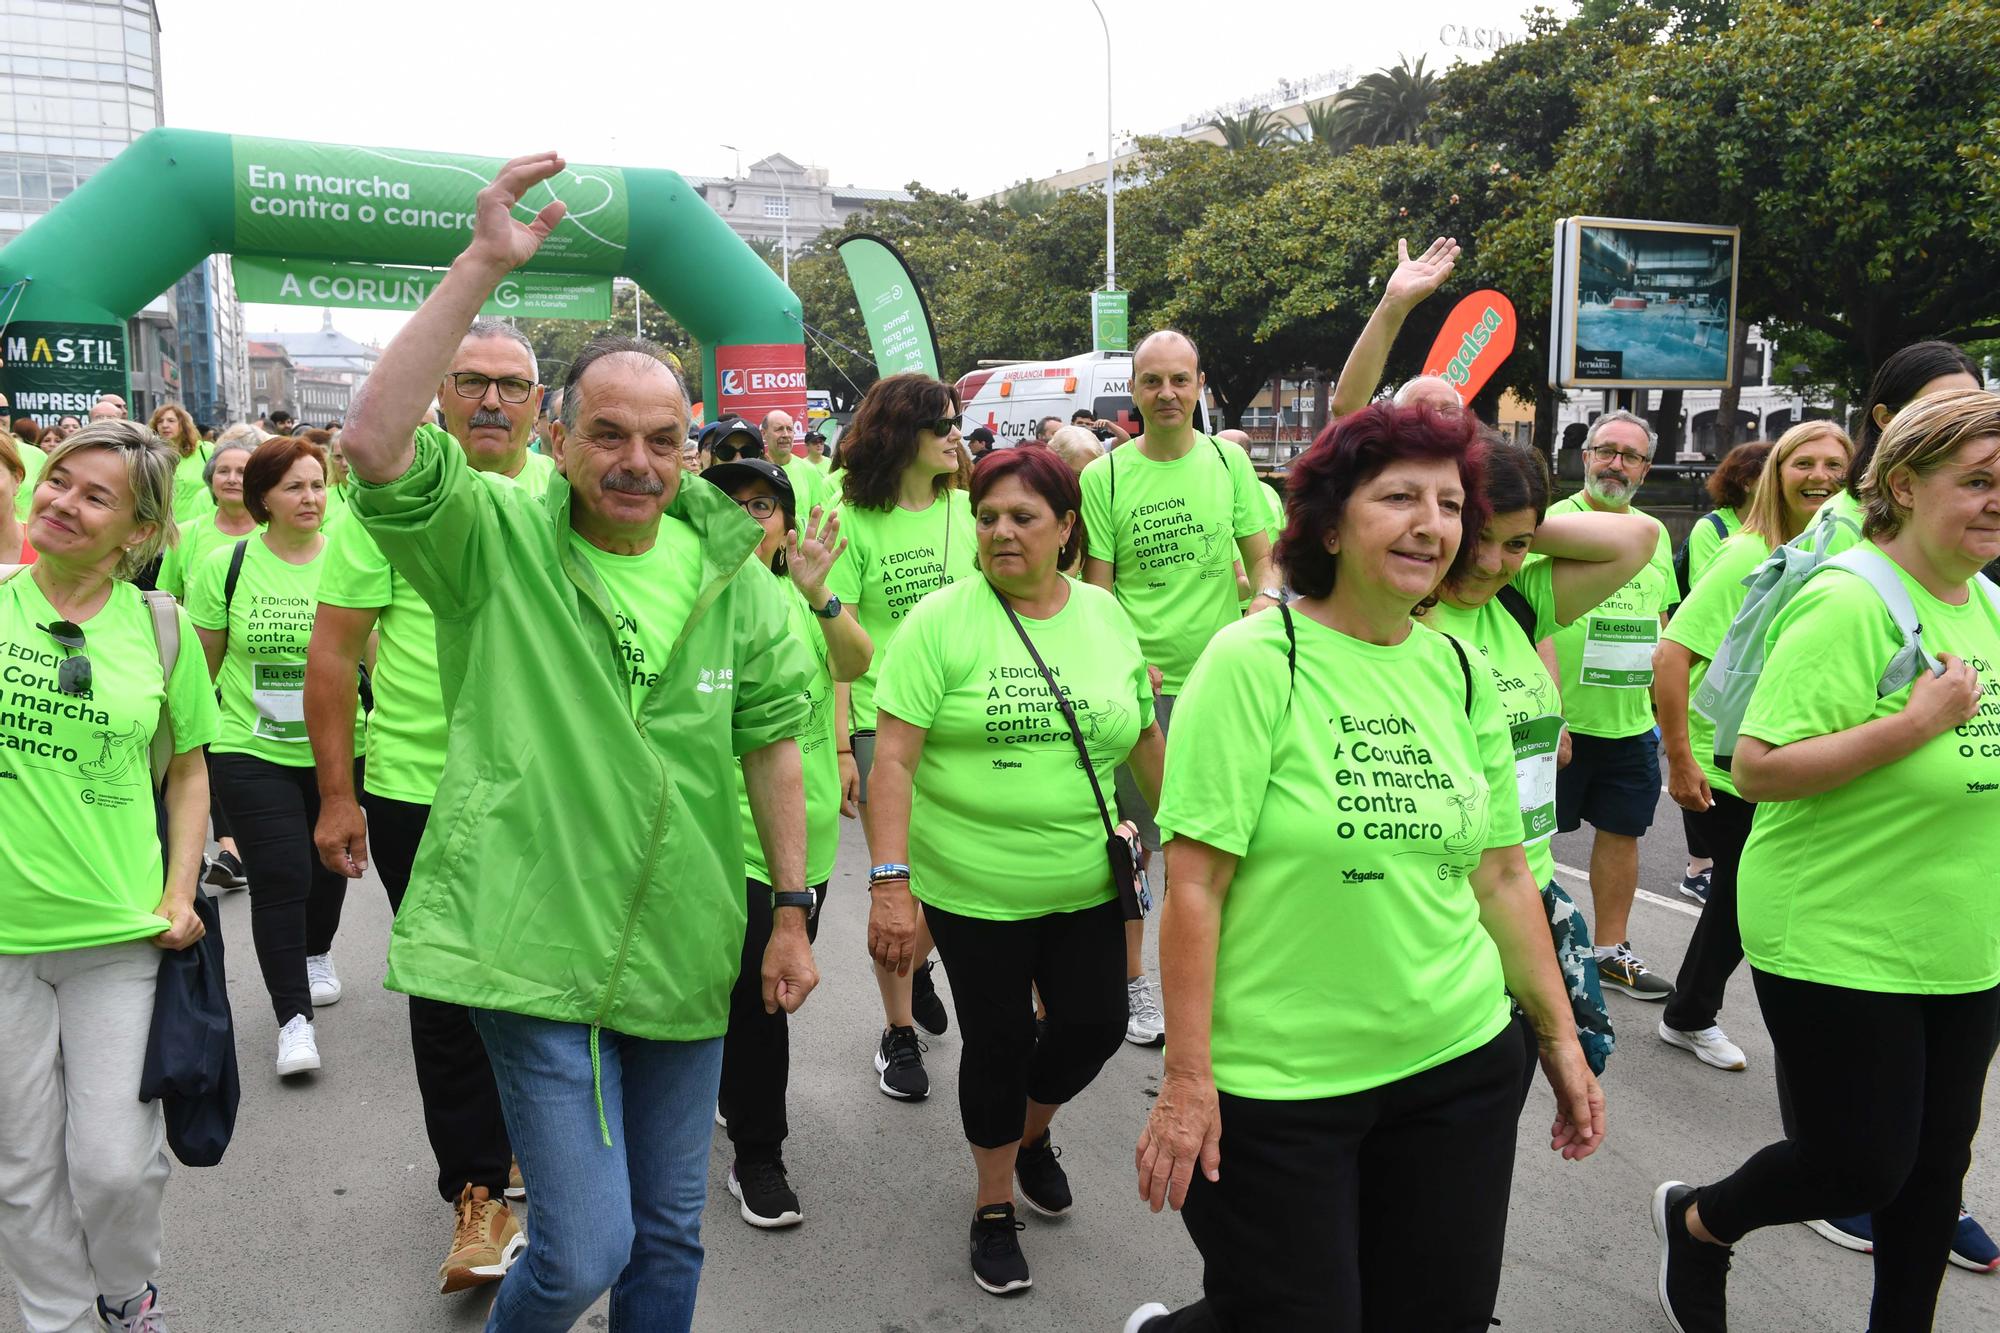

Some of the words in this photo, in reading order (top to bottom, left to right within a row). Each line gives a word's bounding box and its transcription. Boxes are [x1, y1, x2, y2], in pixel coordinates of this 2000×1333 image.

[248, 164, 286, 190] En
[294, 173, 410, 200] marcha
[250, 195, 350, 221] contra
[358, 204, 376, 224] o
[280, 272, 302, 298] A
[309, 275, 438, 304] CORUÑ
[7, 336, 118, 364] MASTIL
[1430, 306, 1503, 388] egalsa
[1003, 369, 1043, 380] AMBULANCIA
[16, 390, 102, 412] IMPRESIÓ
[1001, 420, 1025, 437] Cruz
[1131, 508, 1138, 518] X
[1140, 498, 1185, 516] EDICIÓN
[1132, 523, 1140, 534] A
[1144, 512, 1192, 530] Coruña
[1134, 536, 1149, 546] en
[1153, 524, 1204, 542] marcha
[880, 556, 888, 567] X
[890, 546, 934, 564] EDICIÓN
[1136, 542, 1178, 558] contra
[1140, 562, 1146, 570] o
[1150, 552, 1194, 568] cancro
[883, 571, 892, 582] A
[895, 562, 944, 579] Coruña
[885, 584, 902, 595] en
[906, 574, 954, 591] marcha
[251, 596, 258, 604] X
[262, 596, 308, 606] EDICIÓN
[888, 592, 929, 608] contr
[250, 609, 258, 618] A
[262, 609, 314, 620] Coruña
[248, 622, 264, 630] en
[1596, 622, 1610, 631] Eu
[1614, 623, 1642, 632] estou
[247, 632, 294, 642] contra
[248, 646, 256, 654] o
[262, 668, 279, 678] Eu
[989, 668, 997, 681] X
[4, 666, 94, 701] Corua
[987, 686, 1000, 700] A
[1005, 684, 1072, 698] Corua
[10, 692, 110, 726] marcha
[986, 702, 1011, 715] en
[0, 712, 52, 736] ntra
[986, 716, 1051, 732] contra
[1004, 732, 1072, 744] cancro
[1528, 742, 1550, 750] cancro
[1352, 741, 1432, 764] Coruña
[1959, 744, 1974, 758] o
[992, 759, 1022, 769] Vegalsa
[1336, 769, 1366, 786] en
[1372, 769, 1454, 790] marcha
[1966, 782, 2000, 792] Vegalsa
[1337, 792, 1416, 814] contra
[1337, 822, 1355, 839] o
[1364, 822, 1442, 840] cancro
[1342, 868, 1384, 882] Vegalsa
